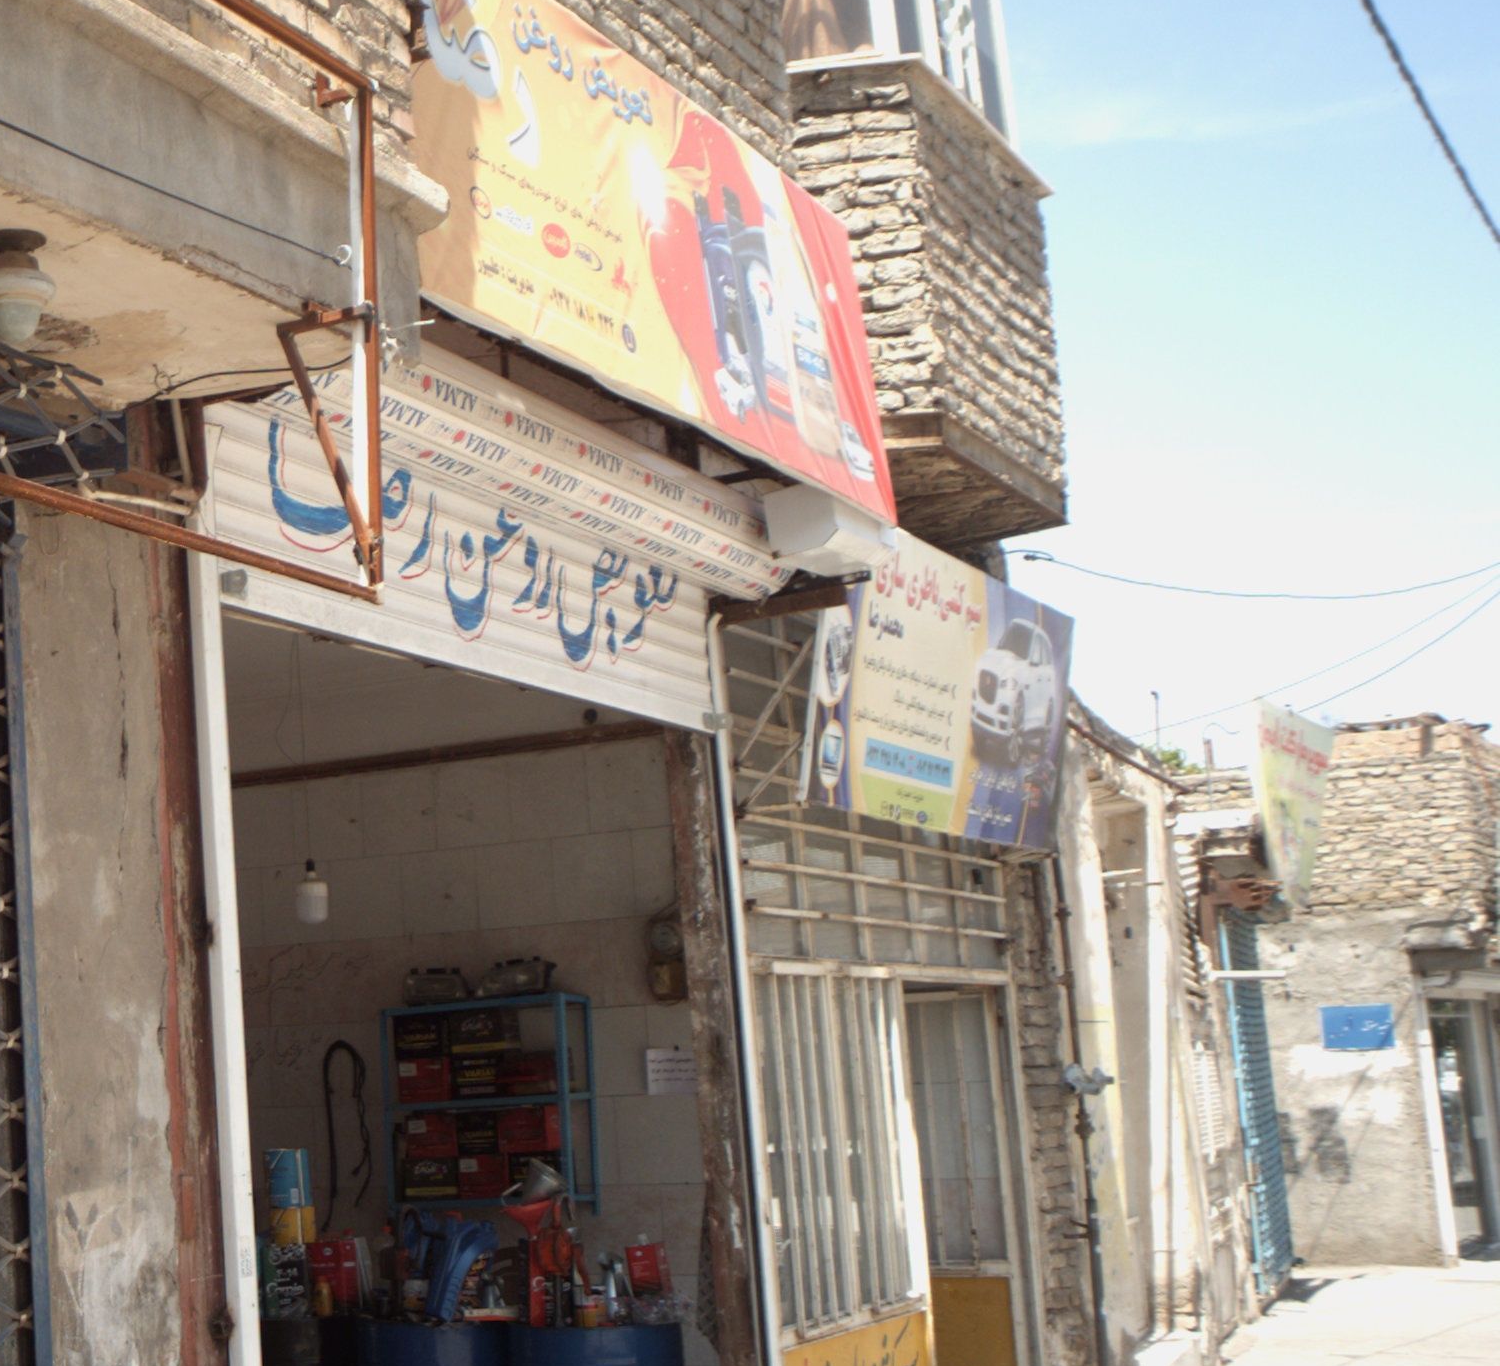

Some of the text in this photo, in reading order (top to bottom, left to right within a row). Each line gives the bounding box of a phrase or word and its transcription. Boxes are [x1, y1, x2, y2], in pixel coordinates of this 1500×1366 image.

[512, 2, 653, 125] تعویض روغن
[380, 396, 758, 569] ALMA ALMA ALMA ALMA ALMA ALMA
[429, 453, 737, 580] ALMA ALMA ALMA ALMA ALMA
[434, 379, 741, 528] ALMA ALMA ALMA ALMA ALMA
[444, 506, 556, 642] روغن
